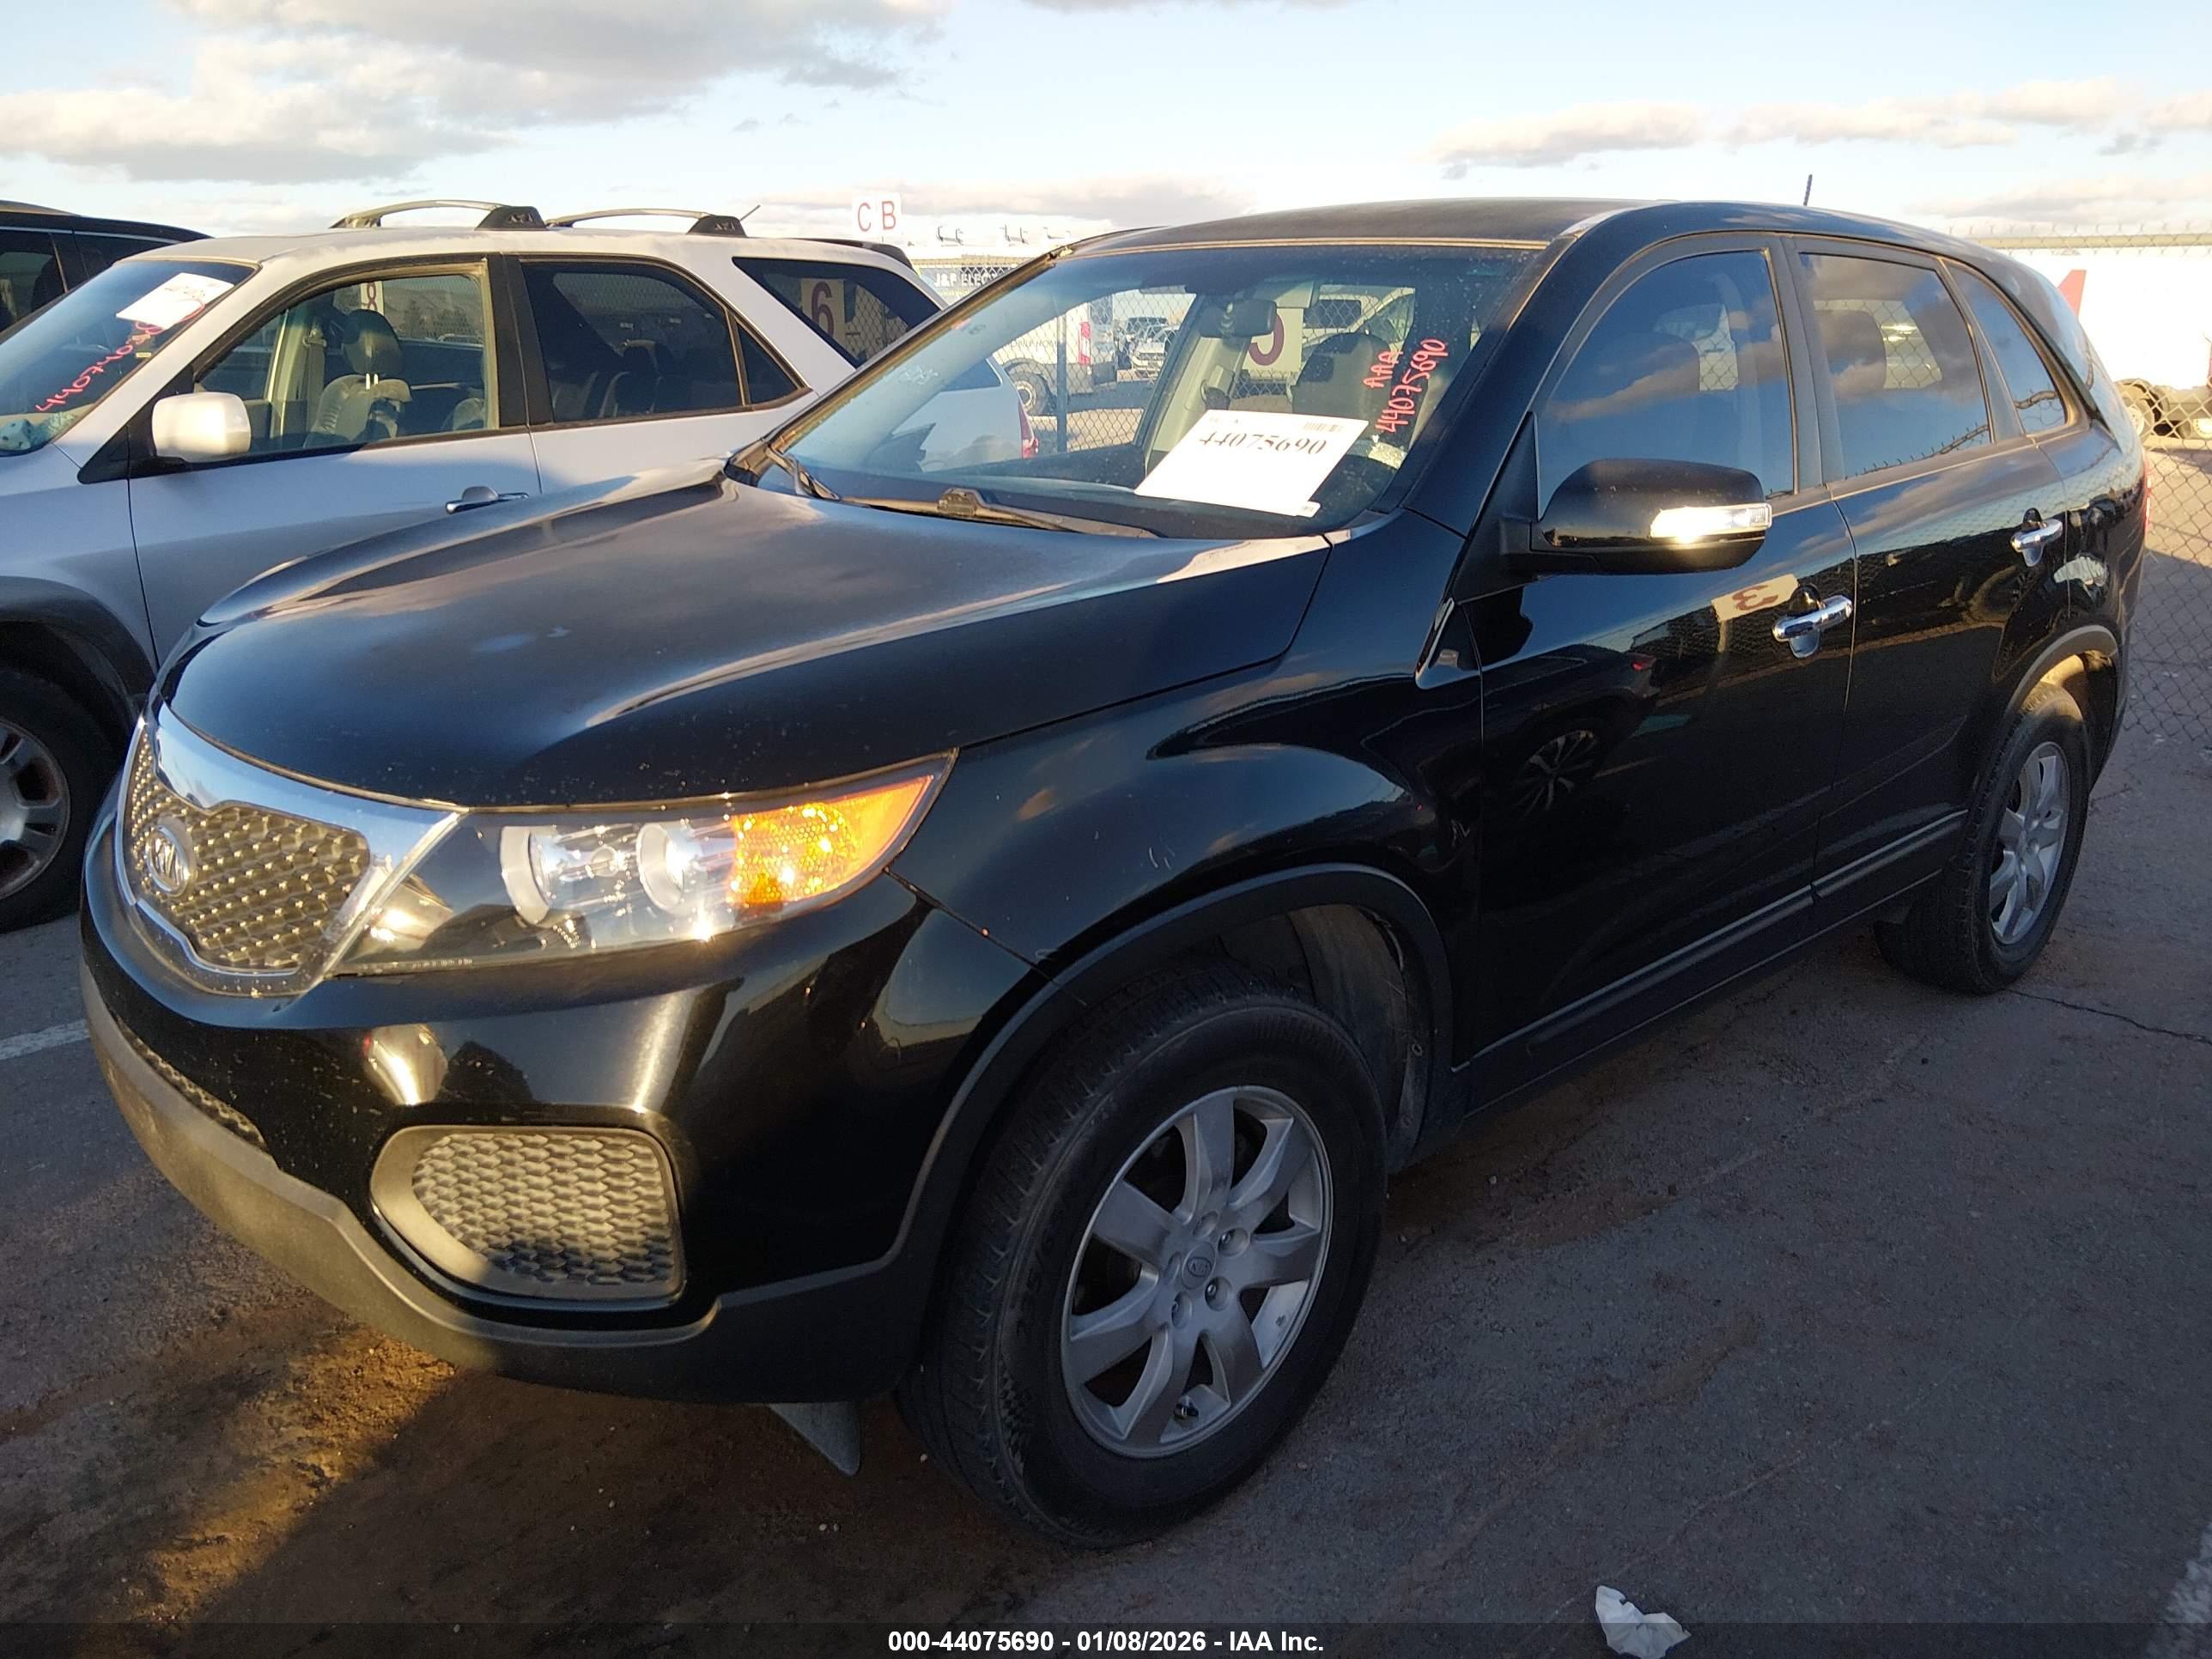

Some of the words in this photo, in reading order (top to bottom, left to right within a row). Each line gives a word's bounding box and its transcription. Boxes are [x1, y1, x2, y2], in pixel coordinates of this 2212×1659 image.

[856, 202, 871, 232] C
[881, 201, 896, 231] B
[811, 281, 835, 338] 6
[1363, 350, 1404, 388] AAA
[1375, 338, 1449, 433] 44075690
[1199, 431, 1327, 454] 44075690
